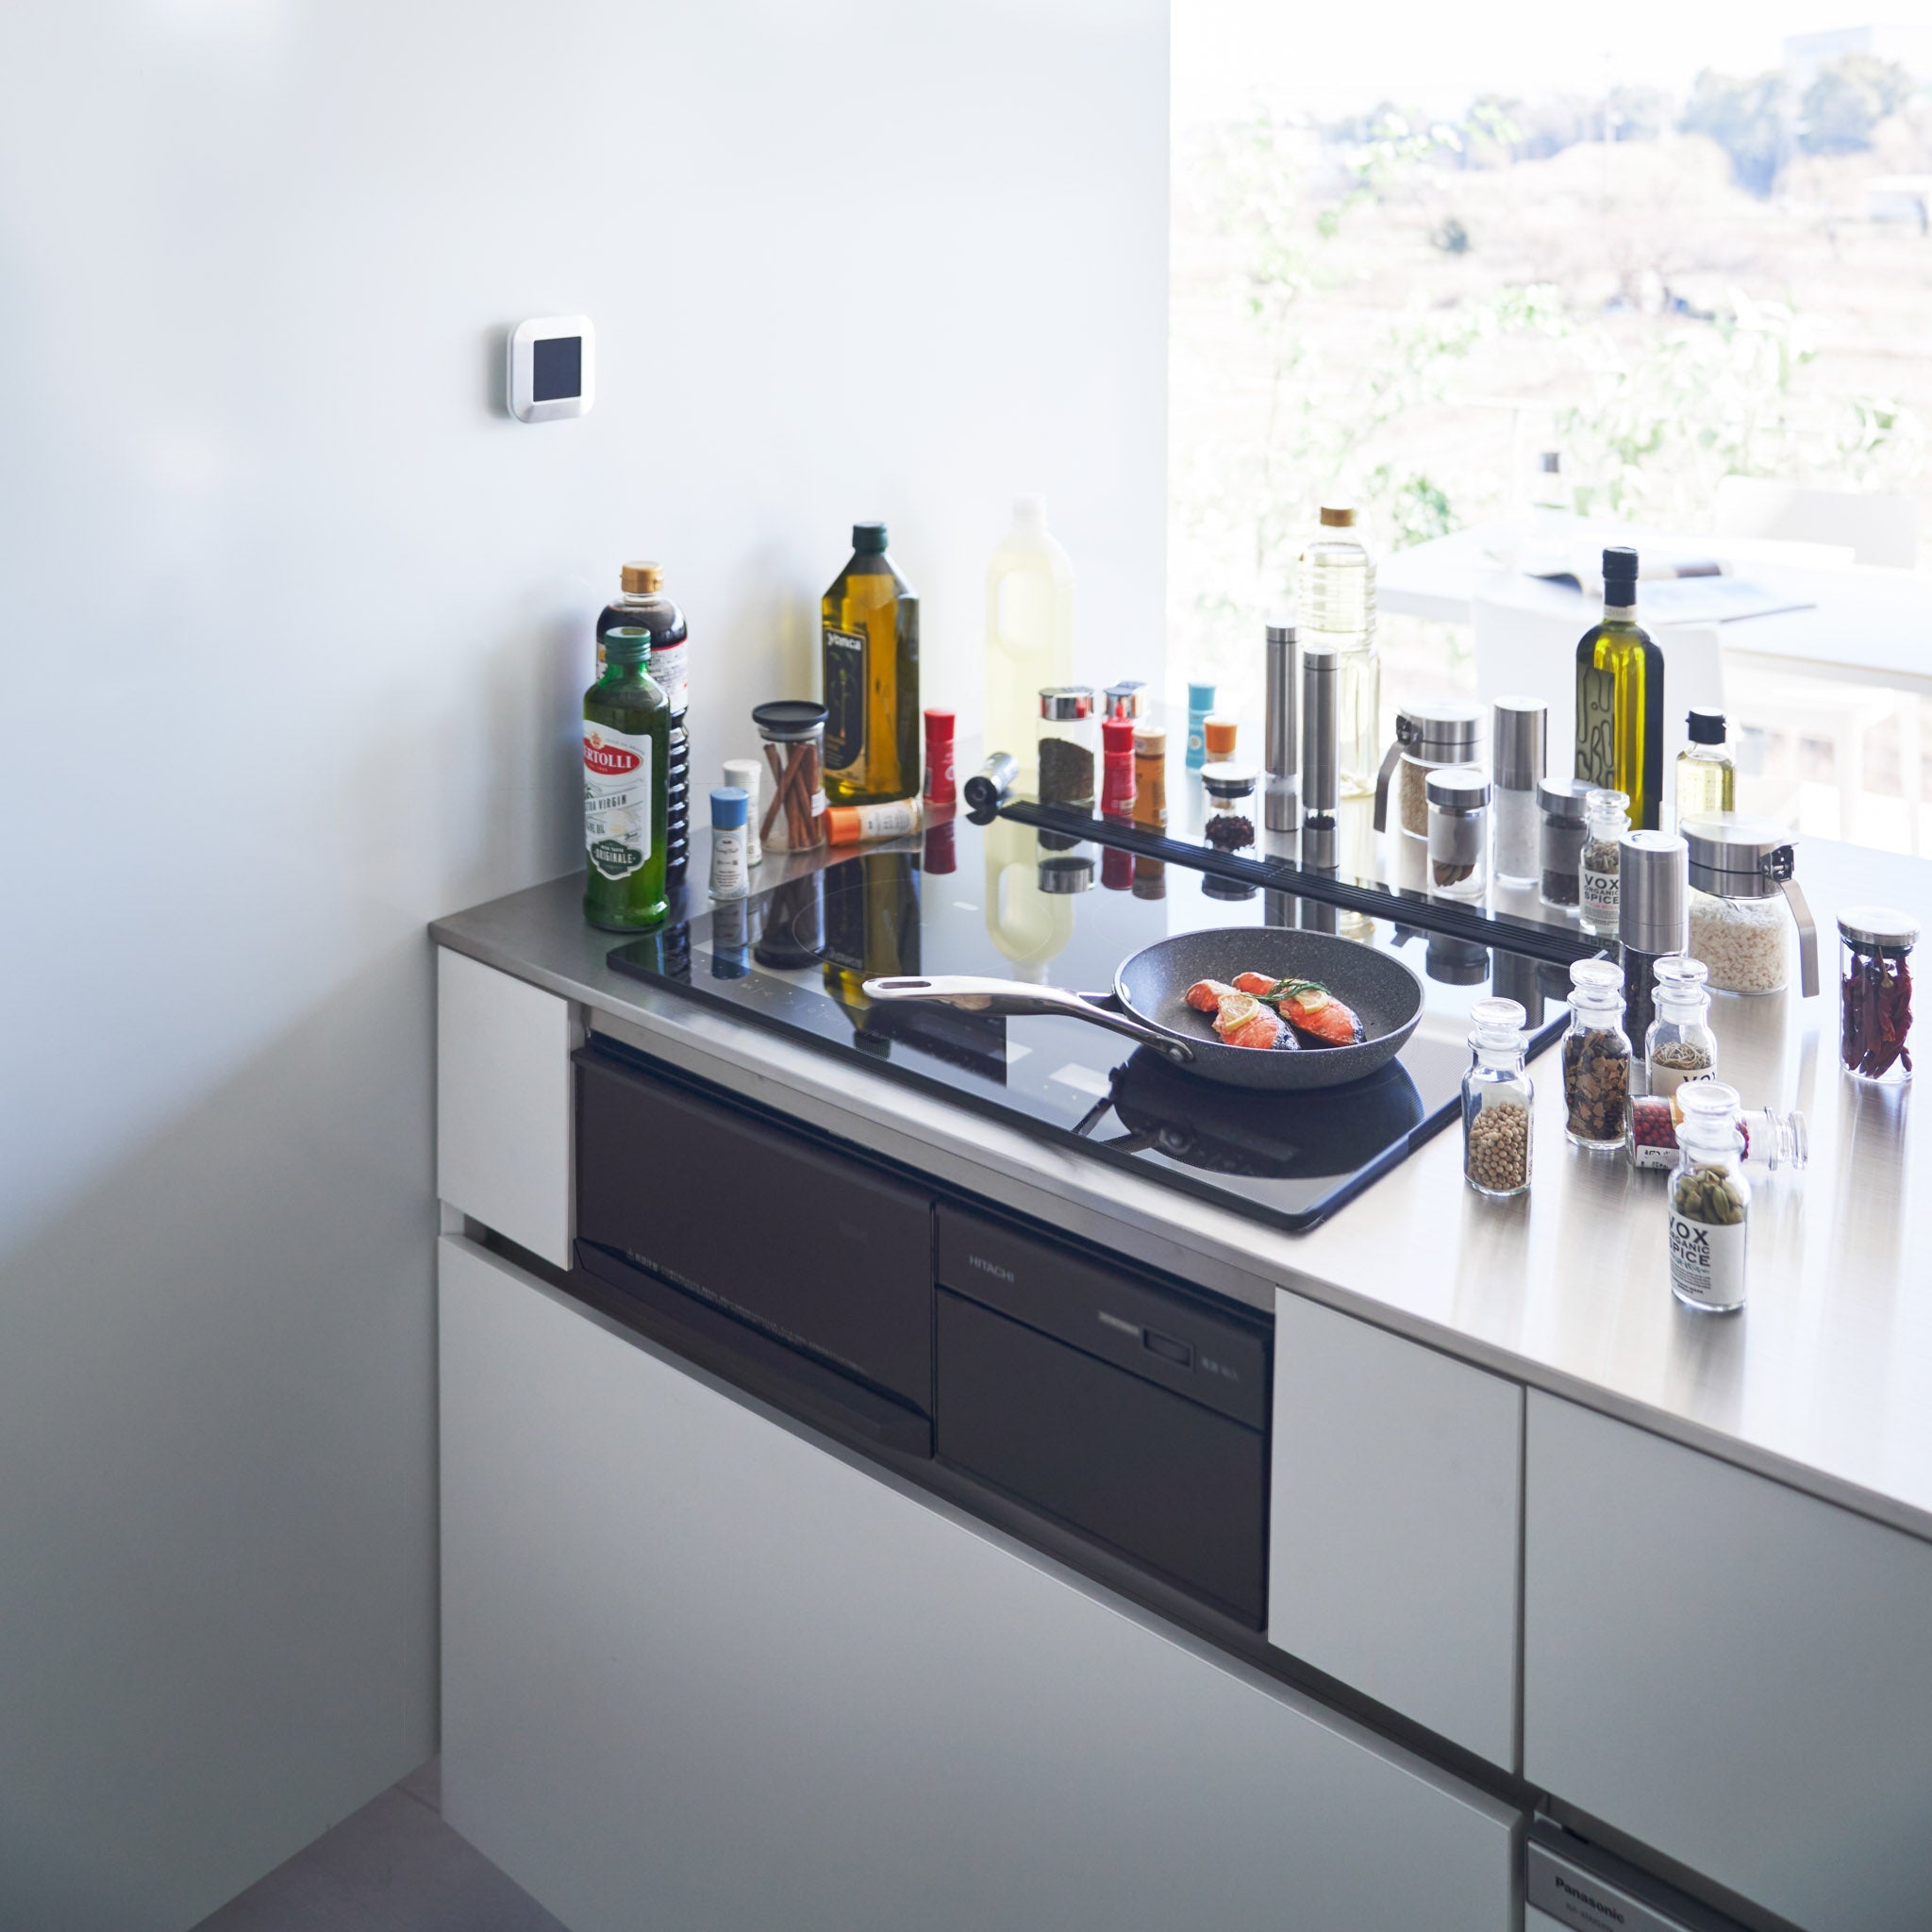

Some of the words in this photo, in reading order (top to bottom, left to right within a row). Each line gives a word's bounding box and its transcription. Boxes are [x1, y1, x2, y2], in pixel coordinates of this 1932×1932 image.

[584, 747, 632, 769] ERTOLLI
[599, 794, 626, 809] VIRGIN
[1585, 874, 1619, 890] VOX
[1585, 891, 1620, 905] SPICE
[1670, 1230, 1710, 1255] RGANIC
[970, 1255, 1014, 1283] HITACHI
[1556, 1875, 1624, 1924] Panasonic
